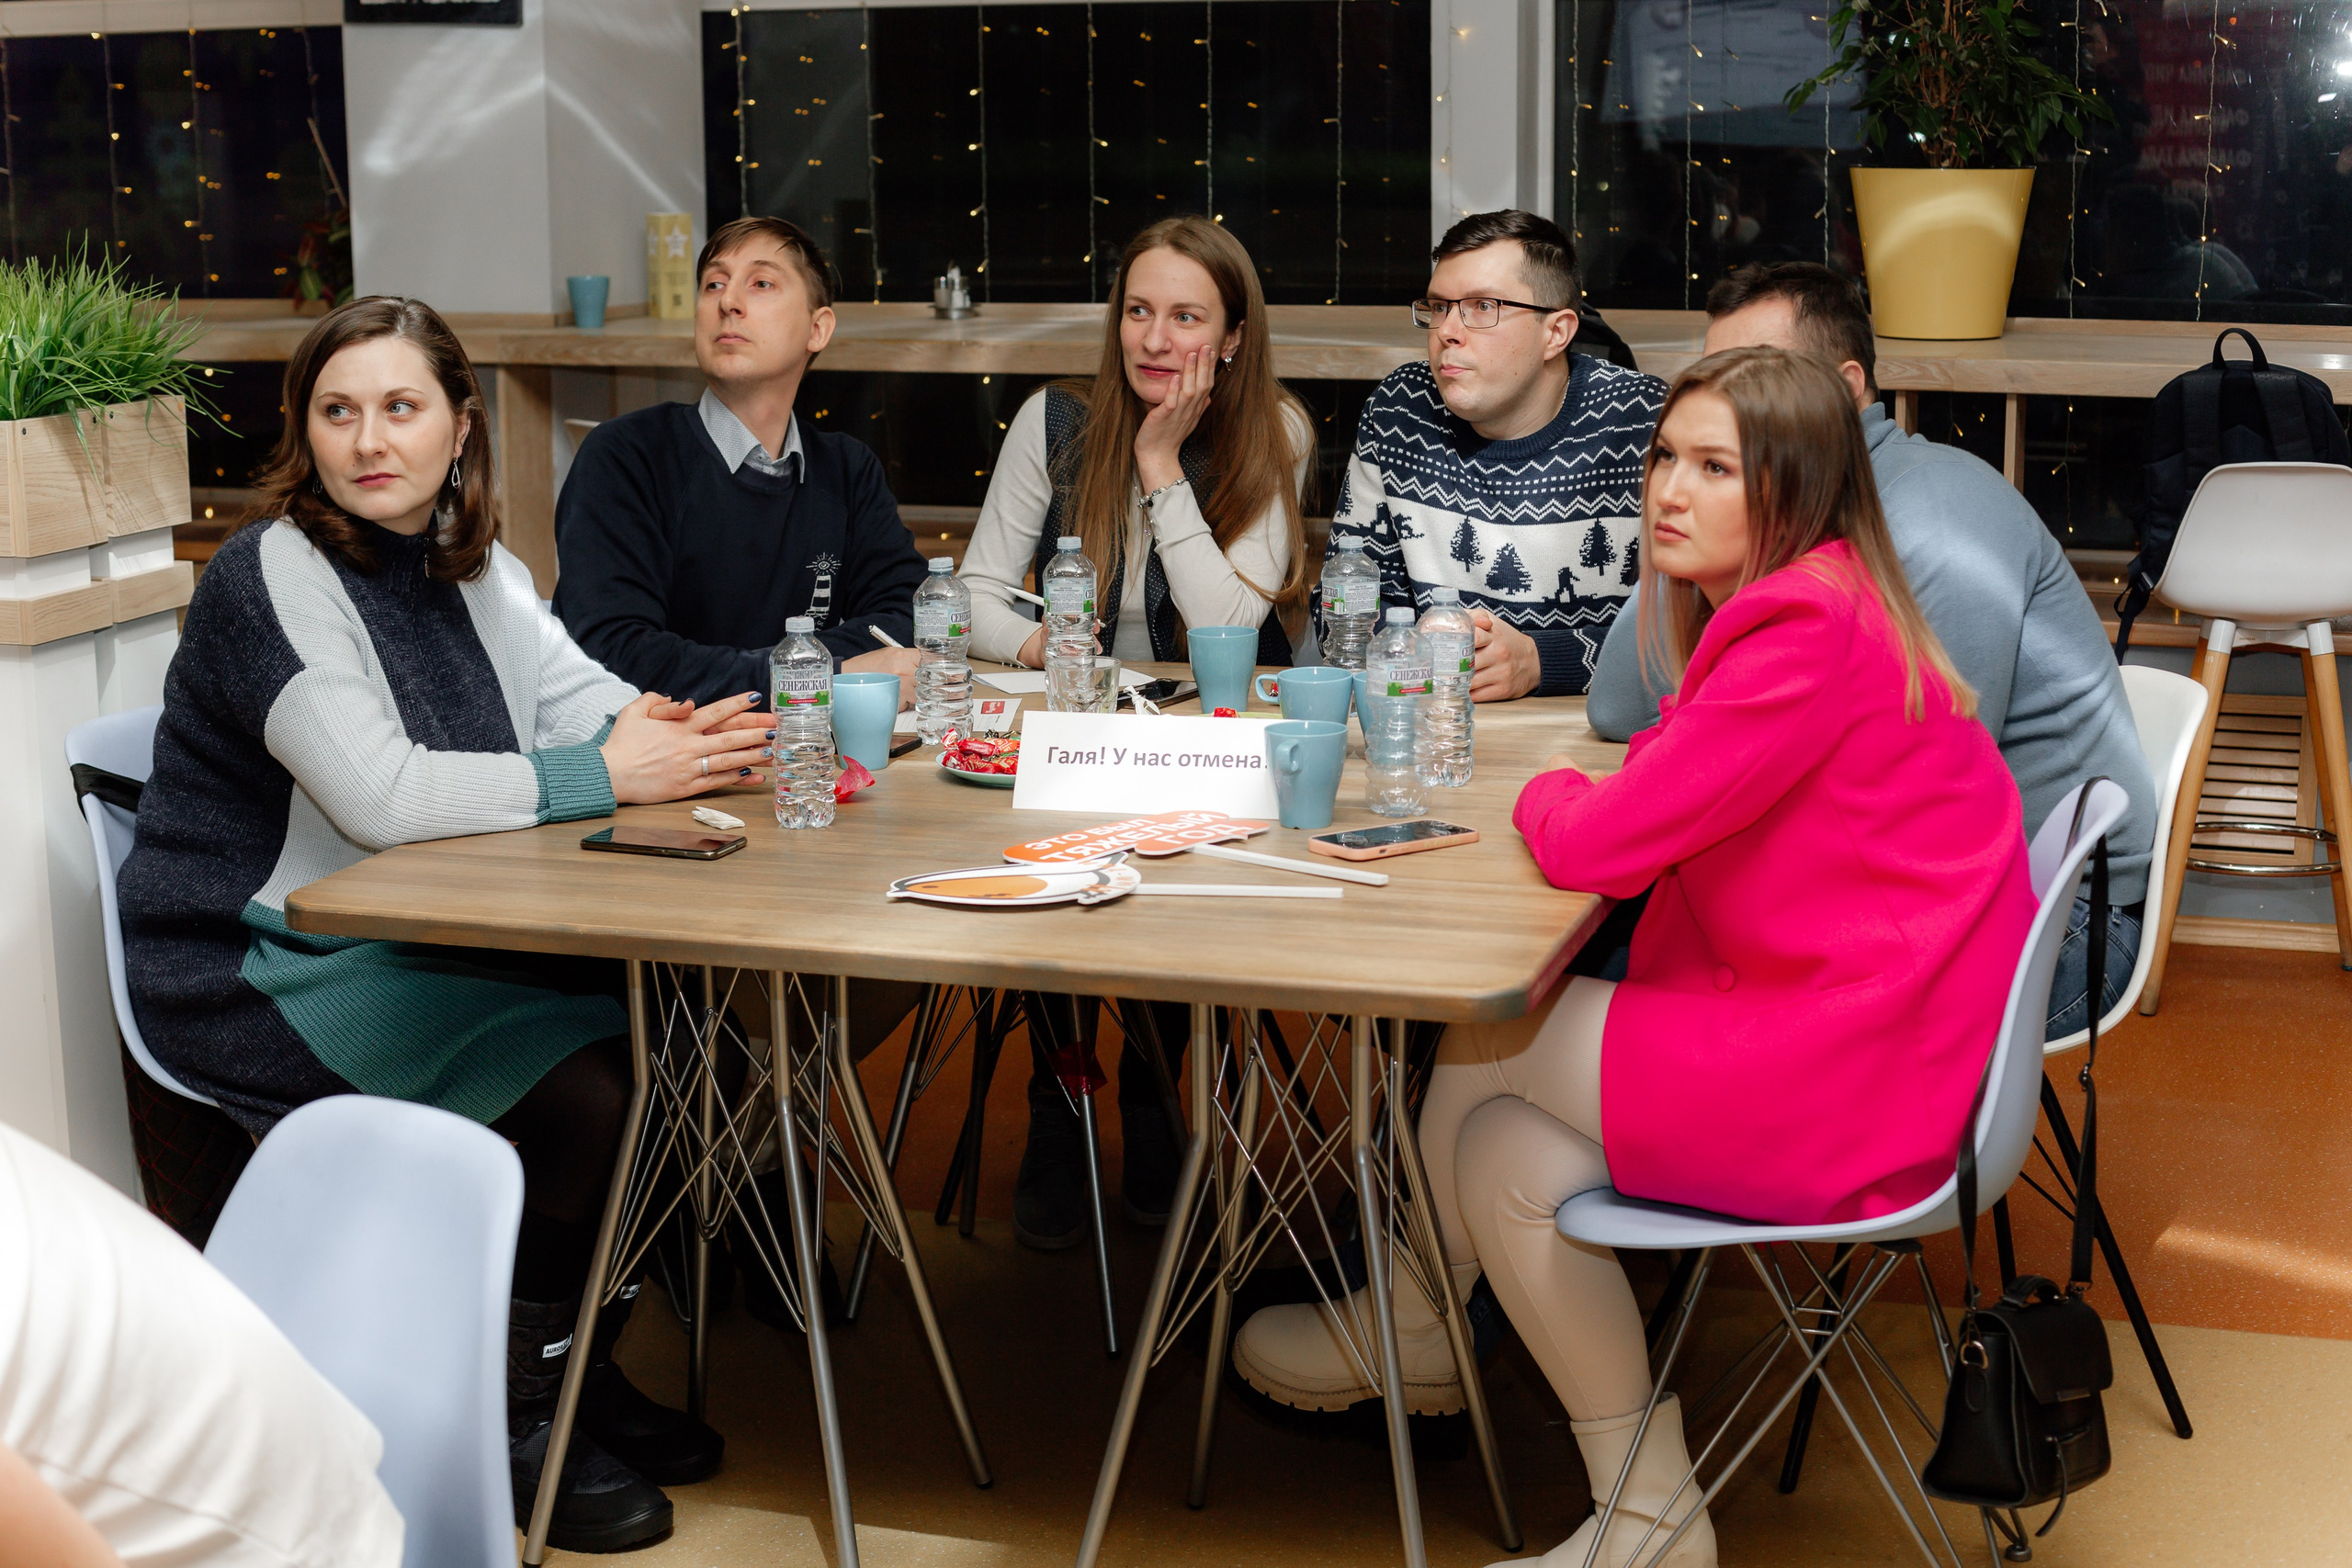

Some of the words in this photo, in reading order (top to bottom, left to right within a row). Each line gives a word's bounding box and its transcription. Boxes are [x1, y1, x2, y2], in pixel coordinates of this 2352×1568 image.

[778, 679, 827, 691] СЕНЕЖСКАЯ
[1046, 746, 1106, 765] Галя!
[1113, 748, 1127, 765] У
[1134, 751, 1171, 767] нас
[1024, 831, 1089, 851] ЭТО
[1084, 818, 1157, 836] БЫЛ
[1039, 812, 1229, 862] ТЯЖЕЛЫЙ
[1154, 823, 1254, 845] ГОД
